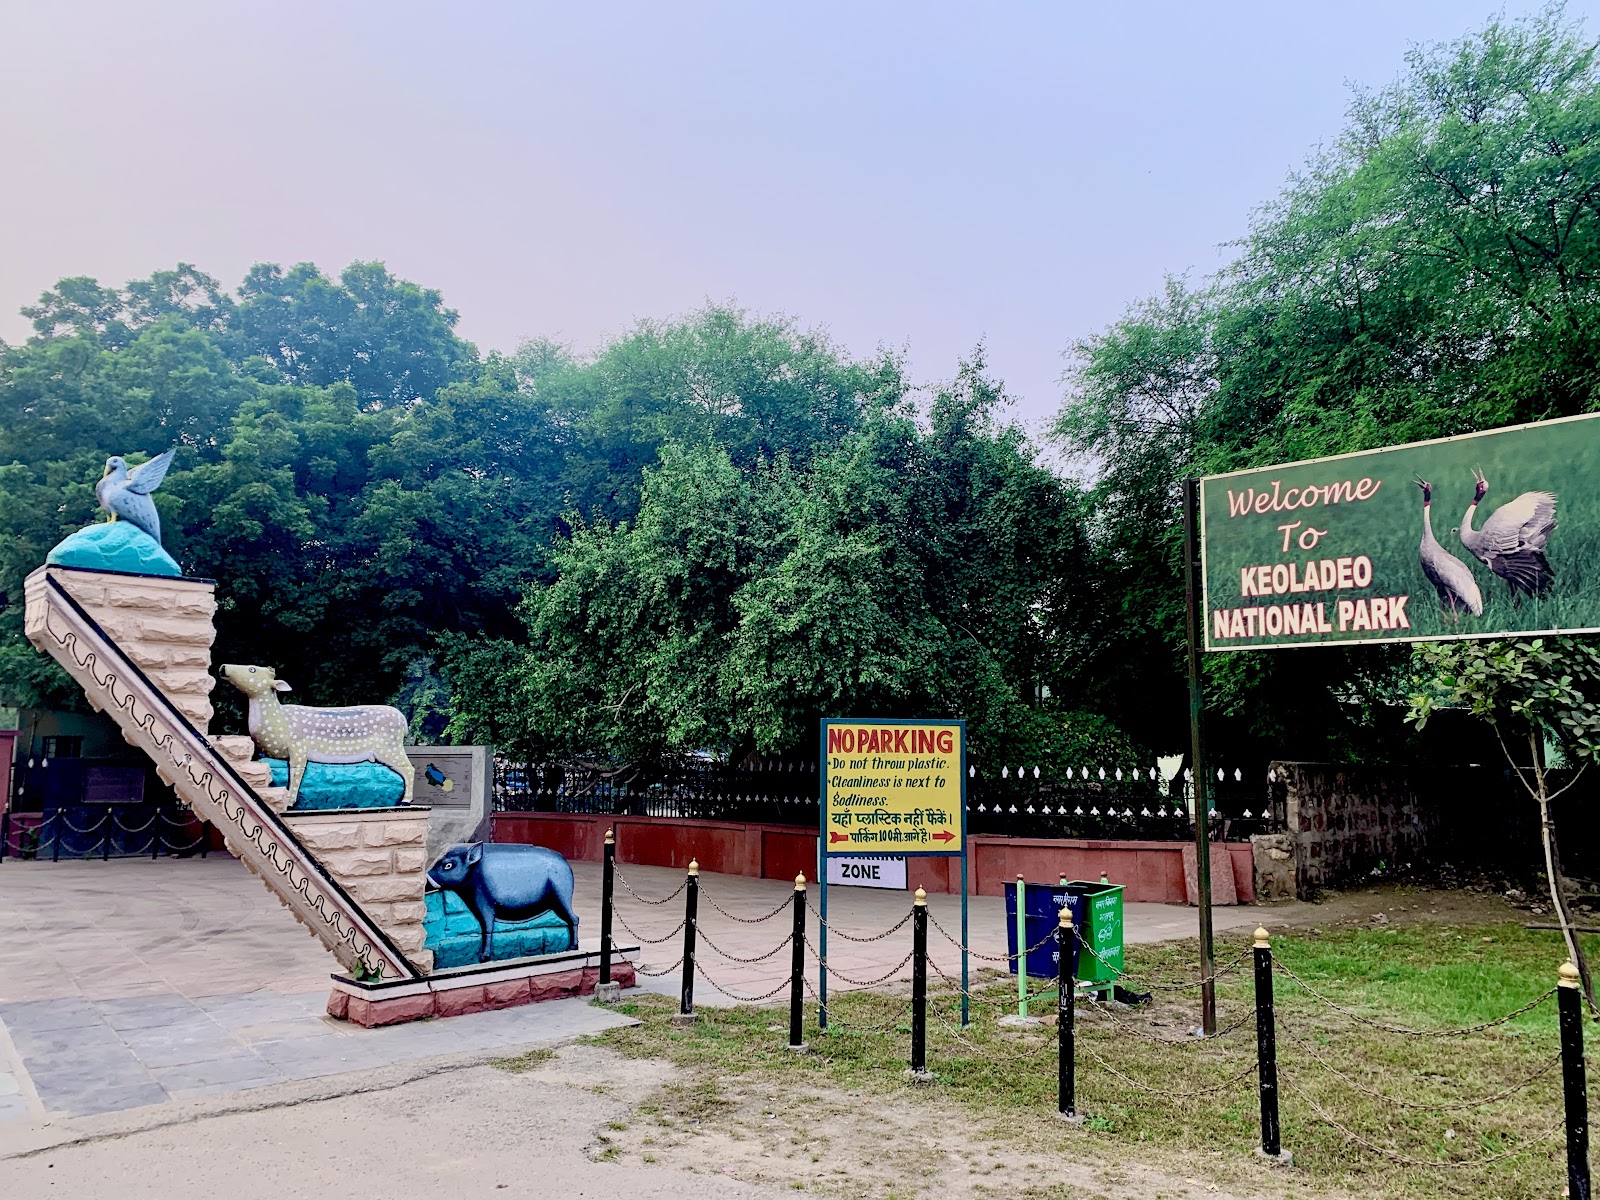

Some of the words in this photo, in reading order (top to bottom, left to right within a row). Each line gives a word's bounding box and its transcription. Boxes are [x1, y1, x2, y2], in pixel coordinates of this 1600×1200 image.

[1226, 476, 1381, 518] Welcome
[1277, 520, 1328, 553] To
[1240, 555, 1373, 598] KEOLADEO
[1213, 600, 1333, 639] NATIONAL
[1338, 596, 1411, 632] PARK
[828, 728, 855, 754] NO
[857, 729, 954, 754] PARKING
[832, 757, 846, 770] Do
[850, 757, 868, 770] not
[872, 757, 906, 770] throw
[907, 757, 950, 772] plastic.
[831, 775, 891, 788] Cleanliness
[893, 775, 903, 788] is
[905, 775, 931, 788] next
[934, 775, 946, 788] to
[831, 808, 852, 828] यहाँ
[854, 808, 902, 826] प्लास्टिक
[903, 808, 924, 828] नहीं
[841, 863, 881, 880] ZONE
